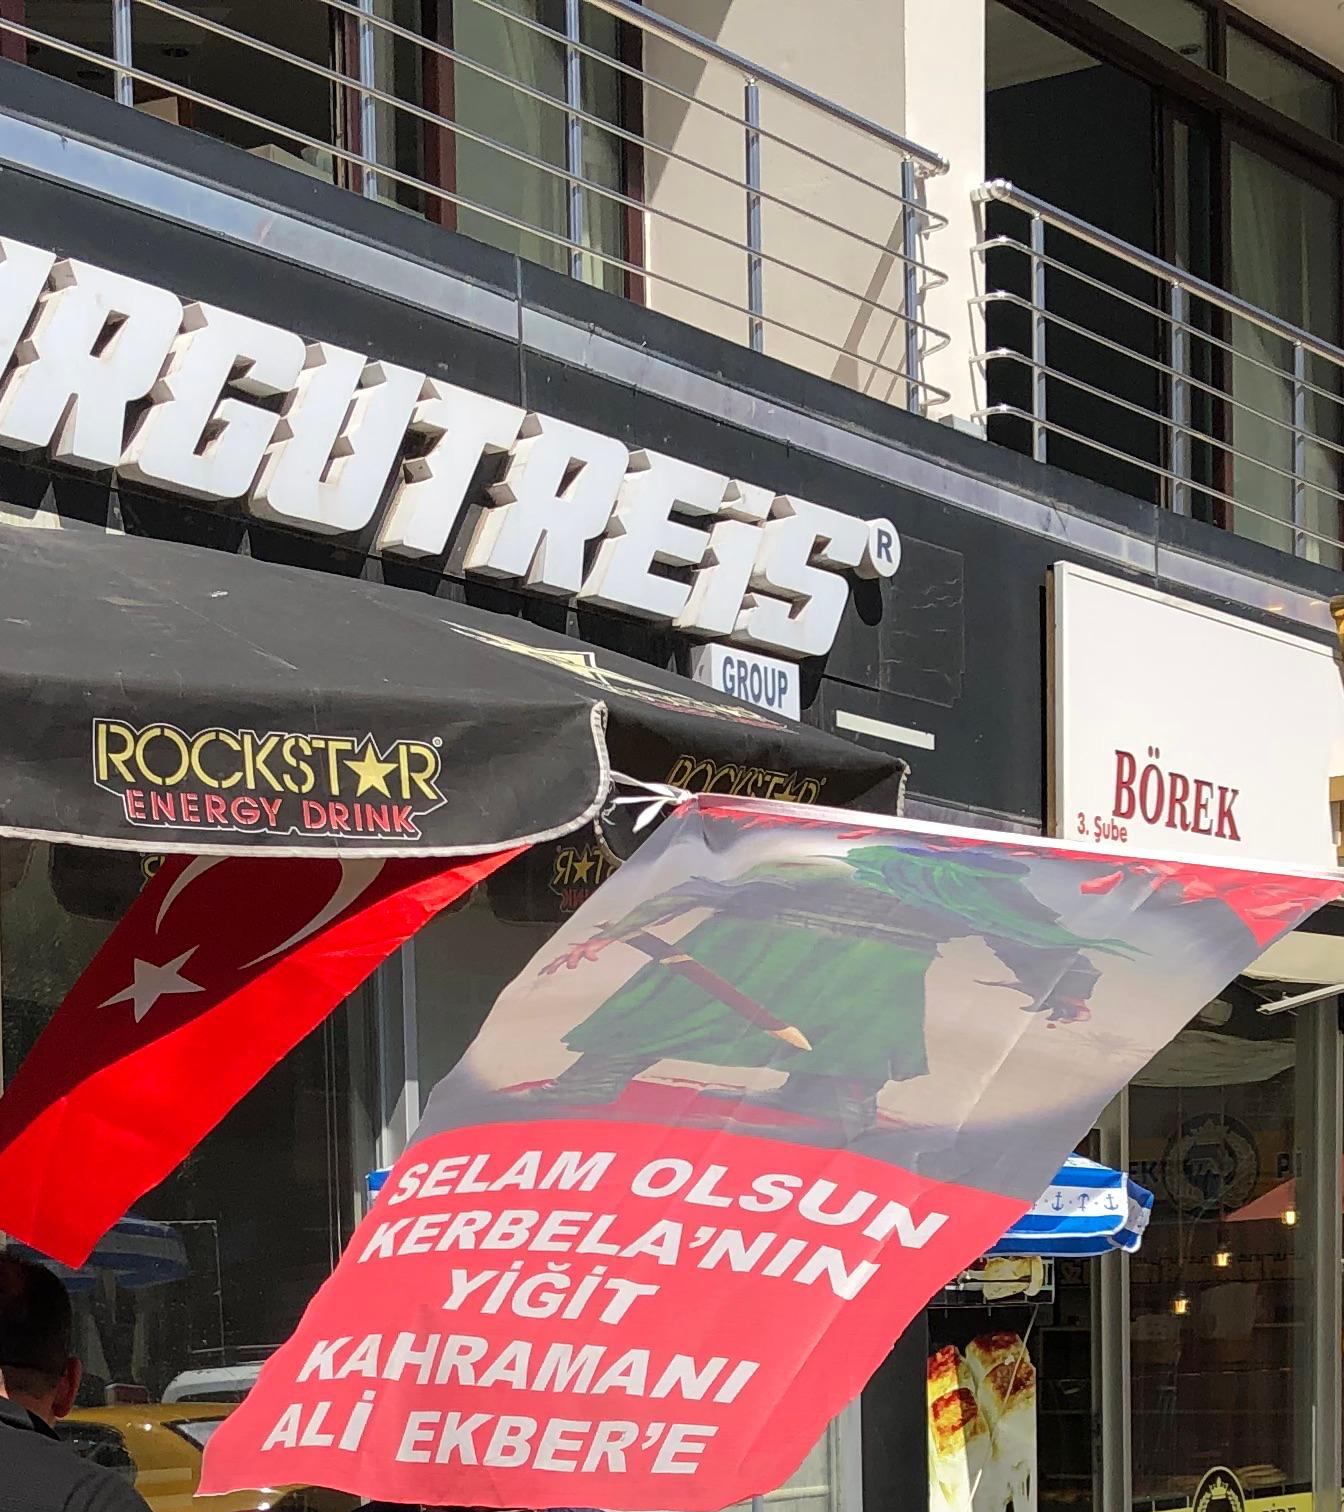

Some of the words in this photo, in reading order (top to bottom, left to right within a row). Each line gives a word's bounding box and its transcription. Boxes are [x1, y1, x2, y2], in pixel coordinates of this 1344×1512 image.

[721, 655, 788, 710] GROUP
[125, 789, 282, 829] ENERGY
[302, 799, 420, 836] DRINK
[1077, 814, 1091, 836] 3.
[1093, 813, 1128, 846] Şube
[1112, 745, 1242, 842] BÖREK
[388, 1150, 617, 1206] SELAM
[631, 1157, 949, 1250] OLSUN
[359, 1209, 880, 1301] KERBELA'NIN
[441, 1263, 660, 1325] YİĞİT
[297, 1331, 761, 1403] KAHRAMANI
[261, 1390, 374, 1452] ALİ
[395, 1410, 719, 1475] EKBER'E
